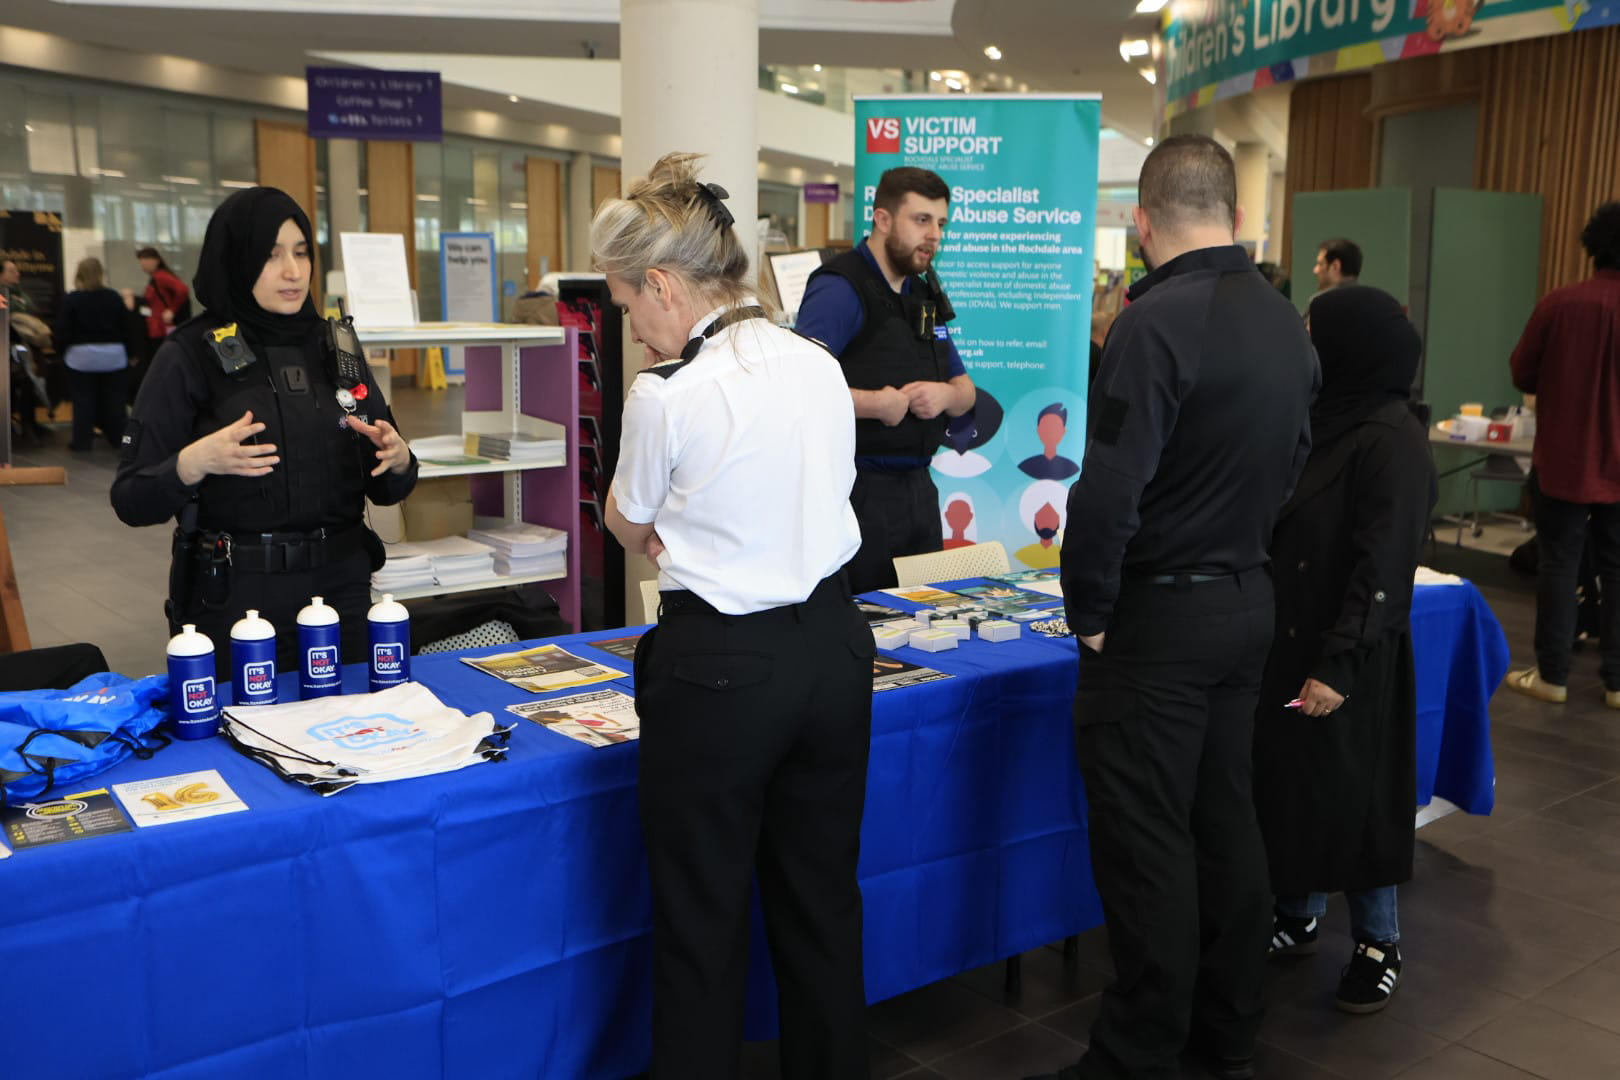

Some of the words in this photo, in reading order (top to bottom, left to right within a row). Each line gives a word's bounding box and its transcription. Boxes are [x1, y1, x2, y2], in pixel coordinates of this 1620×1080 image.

[868, 118, 899, 139] VS
[905, 116, 977, 135] VICTIM
[904, 136, 1002, 154] SUPPORT
[939, 163, 958, 171] ABUSE
[960, 163, 984, 171] SERVICE
[951, 186, 1040, 205] Specialist
[951, 206, 1009, 223] Abuse
[1013, 207, 1082, 225] Service
[947, 230, 961, 240] for
[963, 231, 998, 242] anyone
[999, 231, 1061, 243] experiencing
[943, 243, 961, 252] and
[962, 244, 989, 252] abuse
[991, 244, 1000, 252] in
[1001, 244, 1017, 252] the
[1018, 244, 1061, 254] Rochdale
[1062, 246, 1083, 254] area
[991, 262, 1020, 270] support
[1033, 263, 1062, 271] anyone
[948, 281, 982, 290] specialist
[1049, 282, 1072, 290] abuse
[997, 291, 1032, 300] including
[1013, 302, 1042, 310] support
[311, 652, 328, 660] IT'S
[248, 667, 264, 675] IT'S
[248, 674, 267, 682] NOT
[188, 684, 204, 692] IT'S
[188, 691, 208, 700] NOT
